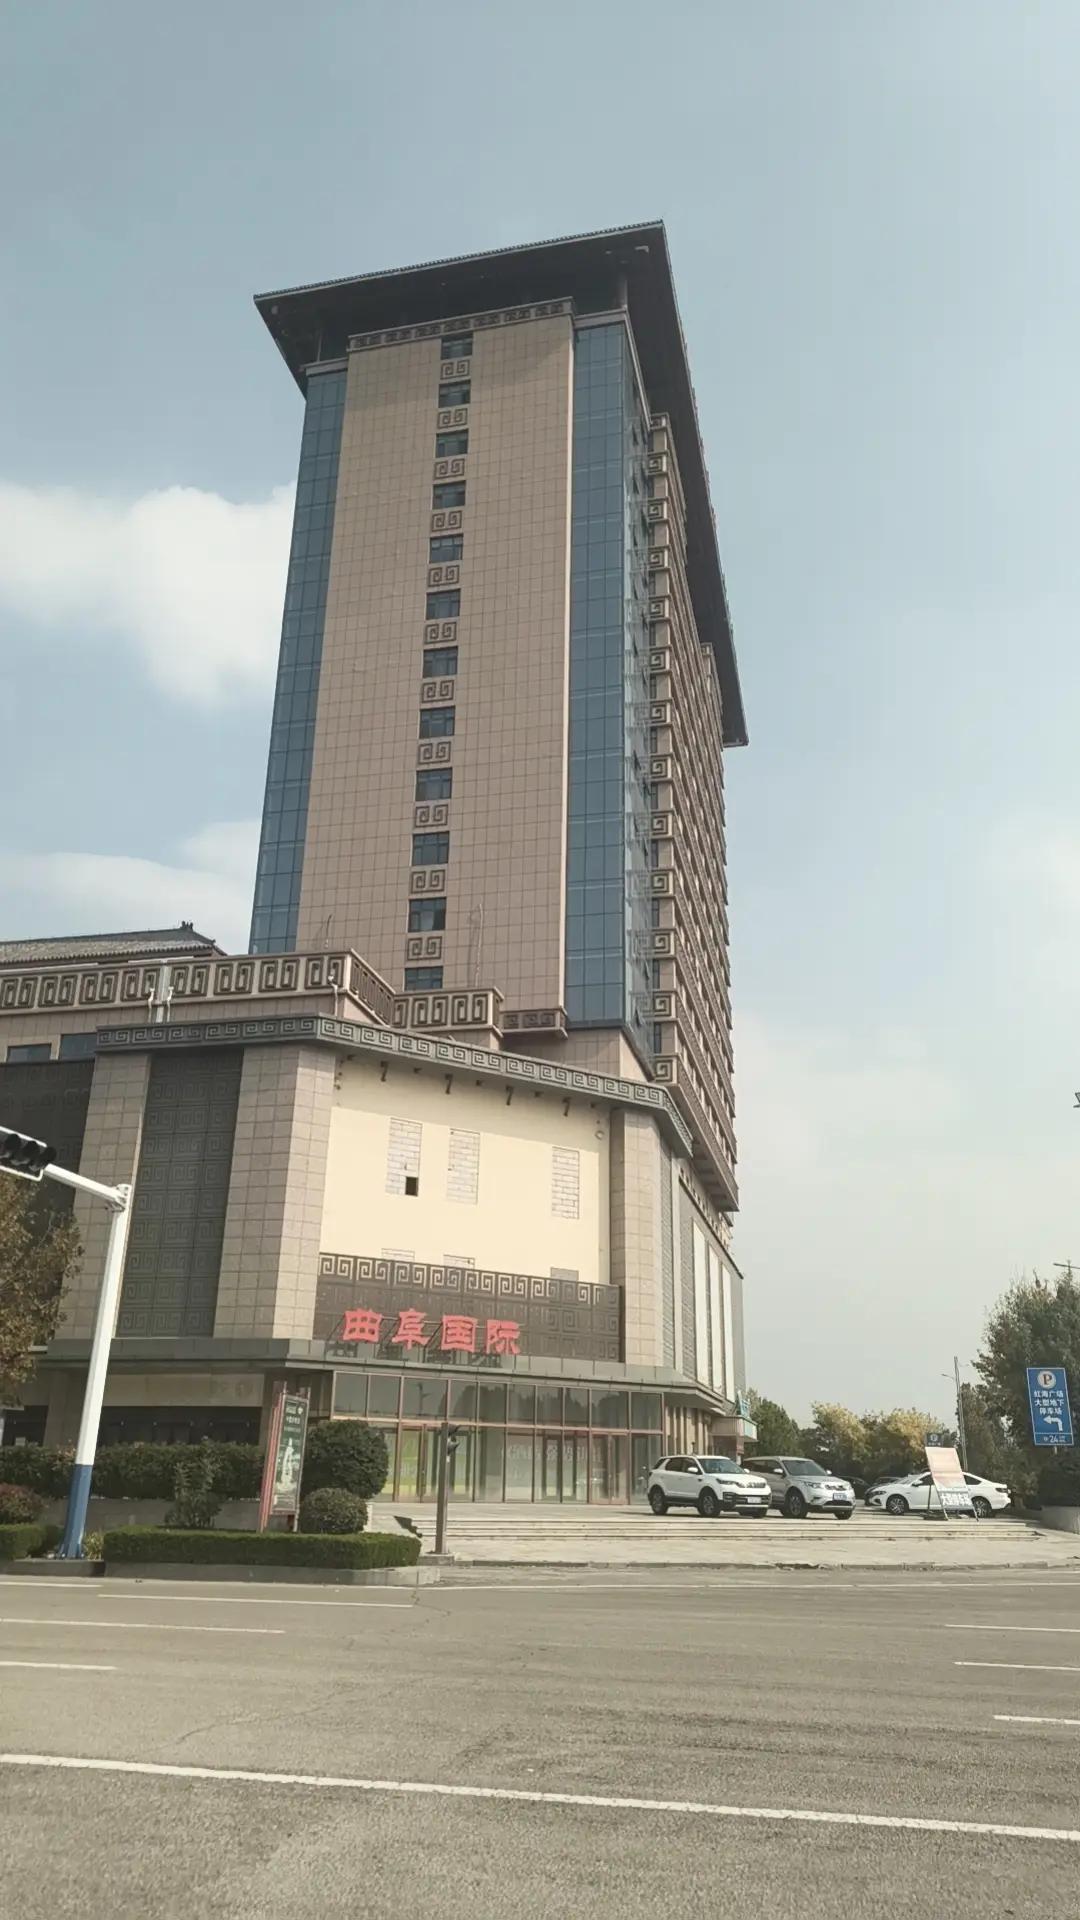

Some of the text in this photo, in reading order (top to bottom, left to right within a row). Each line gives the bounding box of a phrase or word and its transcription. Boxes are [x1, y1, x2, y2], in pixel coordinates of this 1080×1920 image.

[342, 1308, 521, 1355] 曲阜国际
[1043, 1373, 1053, 1385] P
